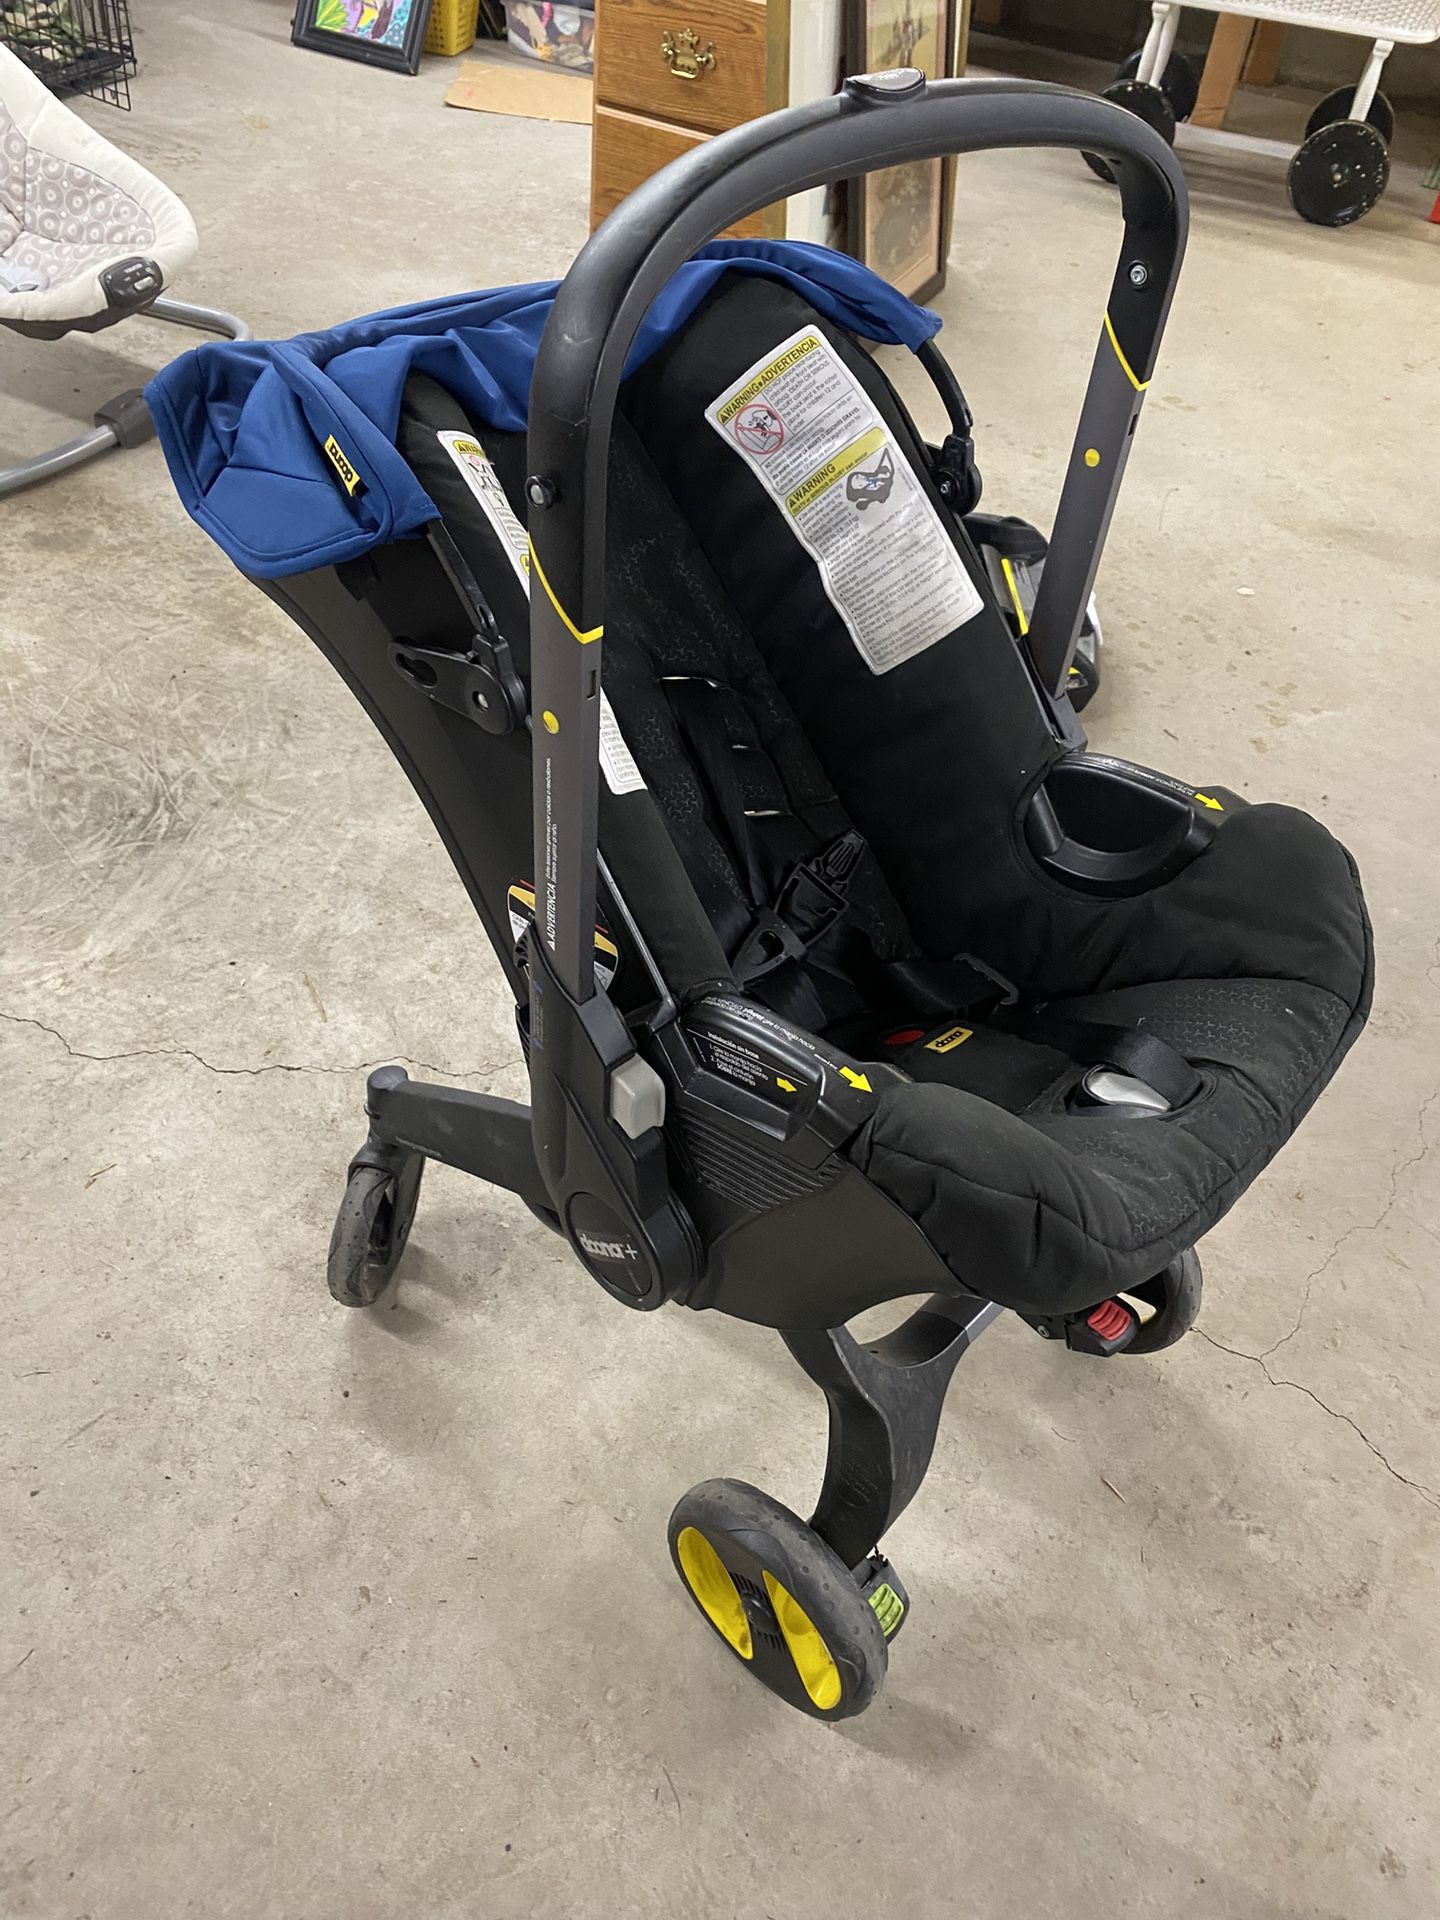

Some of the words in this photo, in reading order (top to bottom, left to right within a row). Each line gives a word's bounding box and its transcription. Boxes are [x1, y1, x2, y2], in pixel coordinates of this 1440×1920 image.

[723, 382, 759, 417] WARNING
[761, 338, 817, 384] ADVERTENCIA
[329, 442, 353, 482] doona
[792, 463, 835, 501] WARNING
[546, 884, 557, 939] ADVERTENCIA
[935, 1031, 963, 1046] doona
